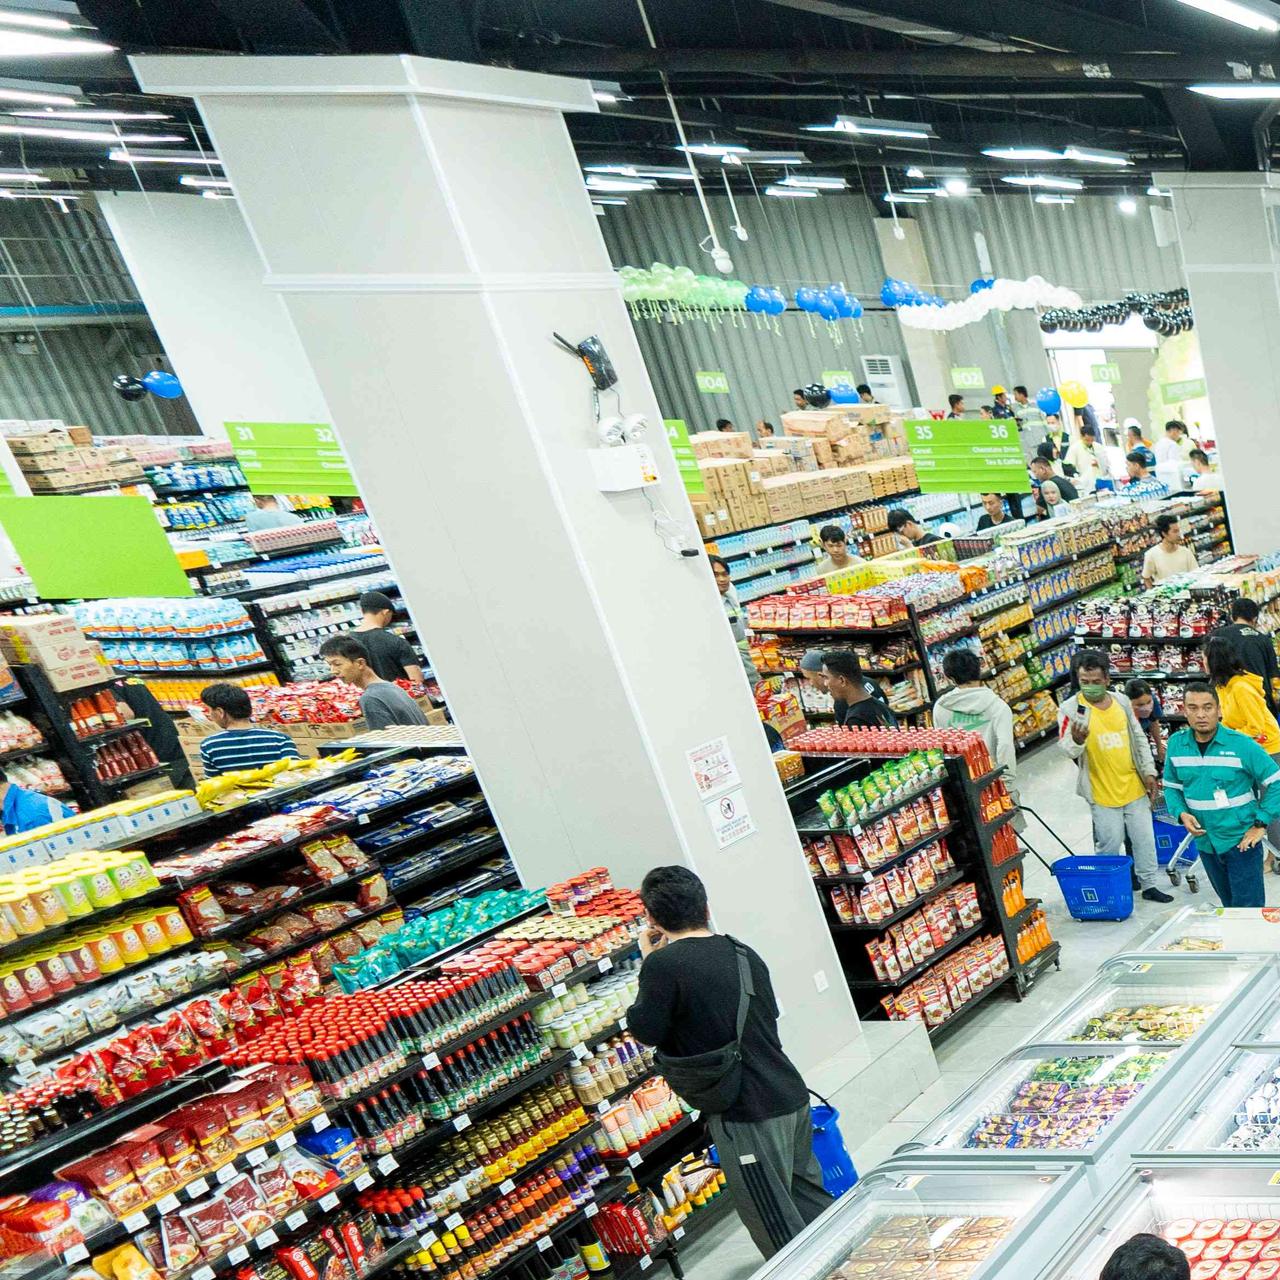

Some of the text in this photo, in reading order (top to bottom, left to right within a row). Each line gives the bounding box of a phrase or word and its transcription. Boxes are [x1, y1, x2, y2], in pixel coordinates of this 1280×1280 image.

[235, 427, 335, 442] 31 32
[915, 425, 1008, 440] 35 36
